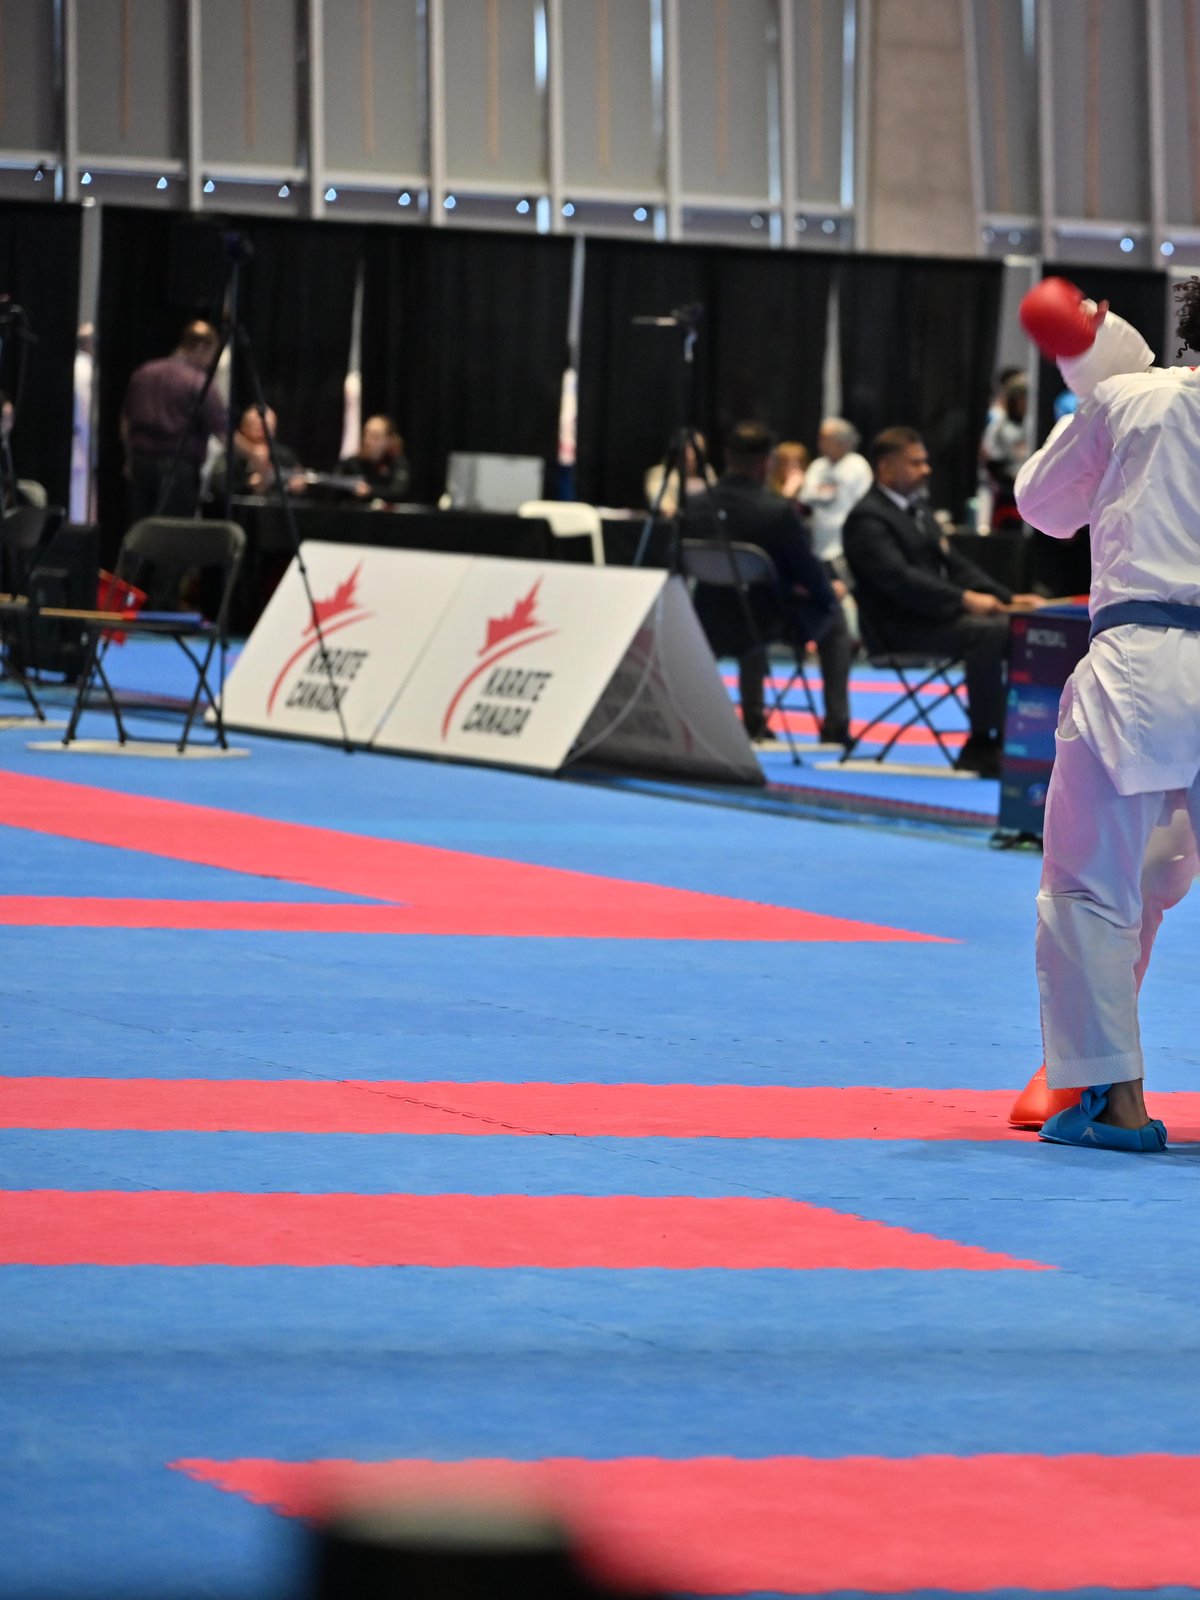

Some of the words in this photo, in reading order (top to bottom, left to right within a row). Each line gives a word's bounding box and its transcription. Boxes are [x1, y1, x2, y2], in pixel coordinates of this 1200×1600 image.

[285, 680, 348, 712] CANADA
[482, 667, 553, 703] KARATE
[462, 702, 532, 737] CANADA
